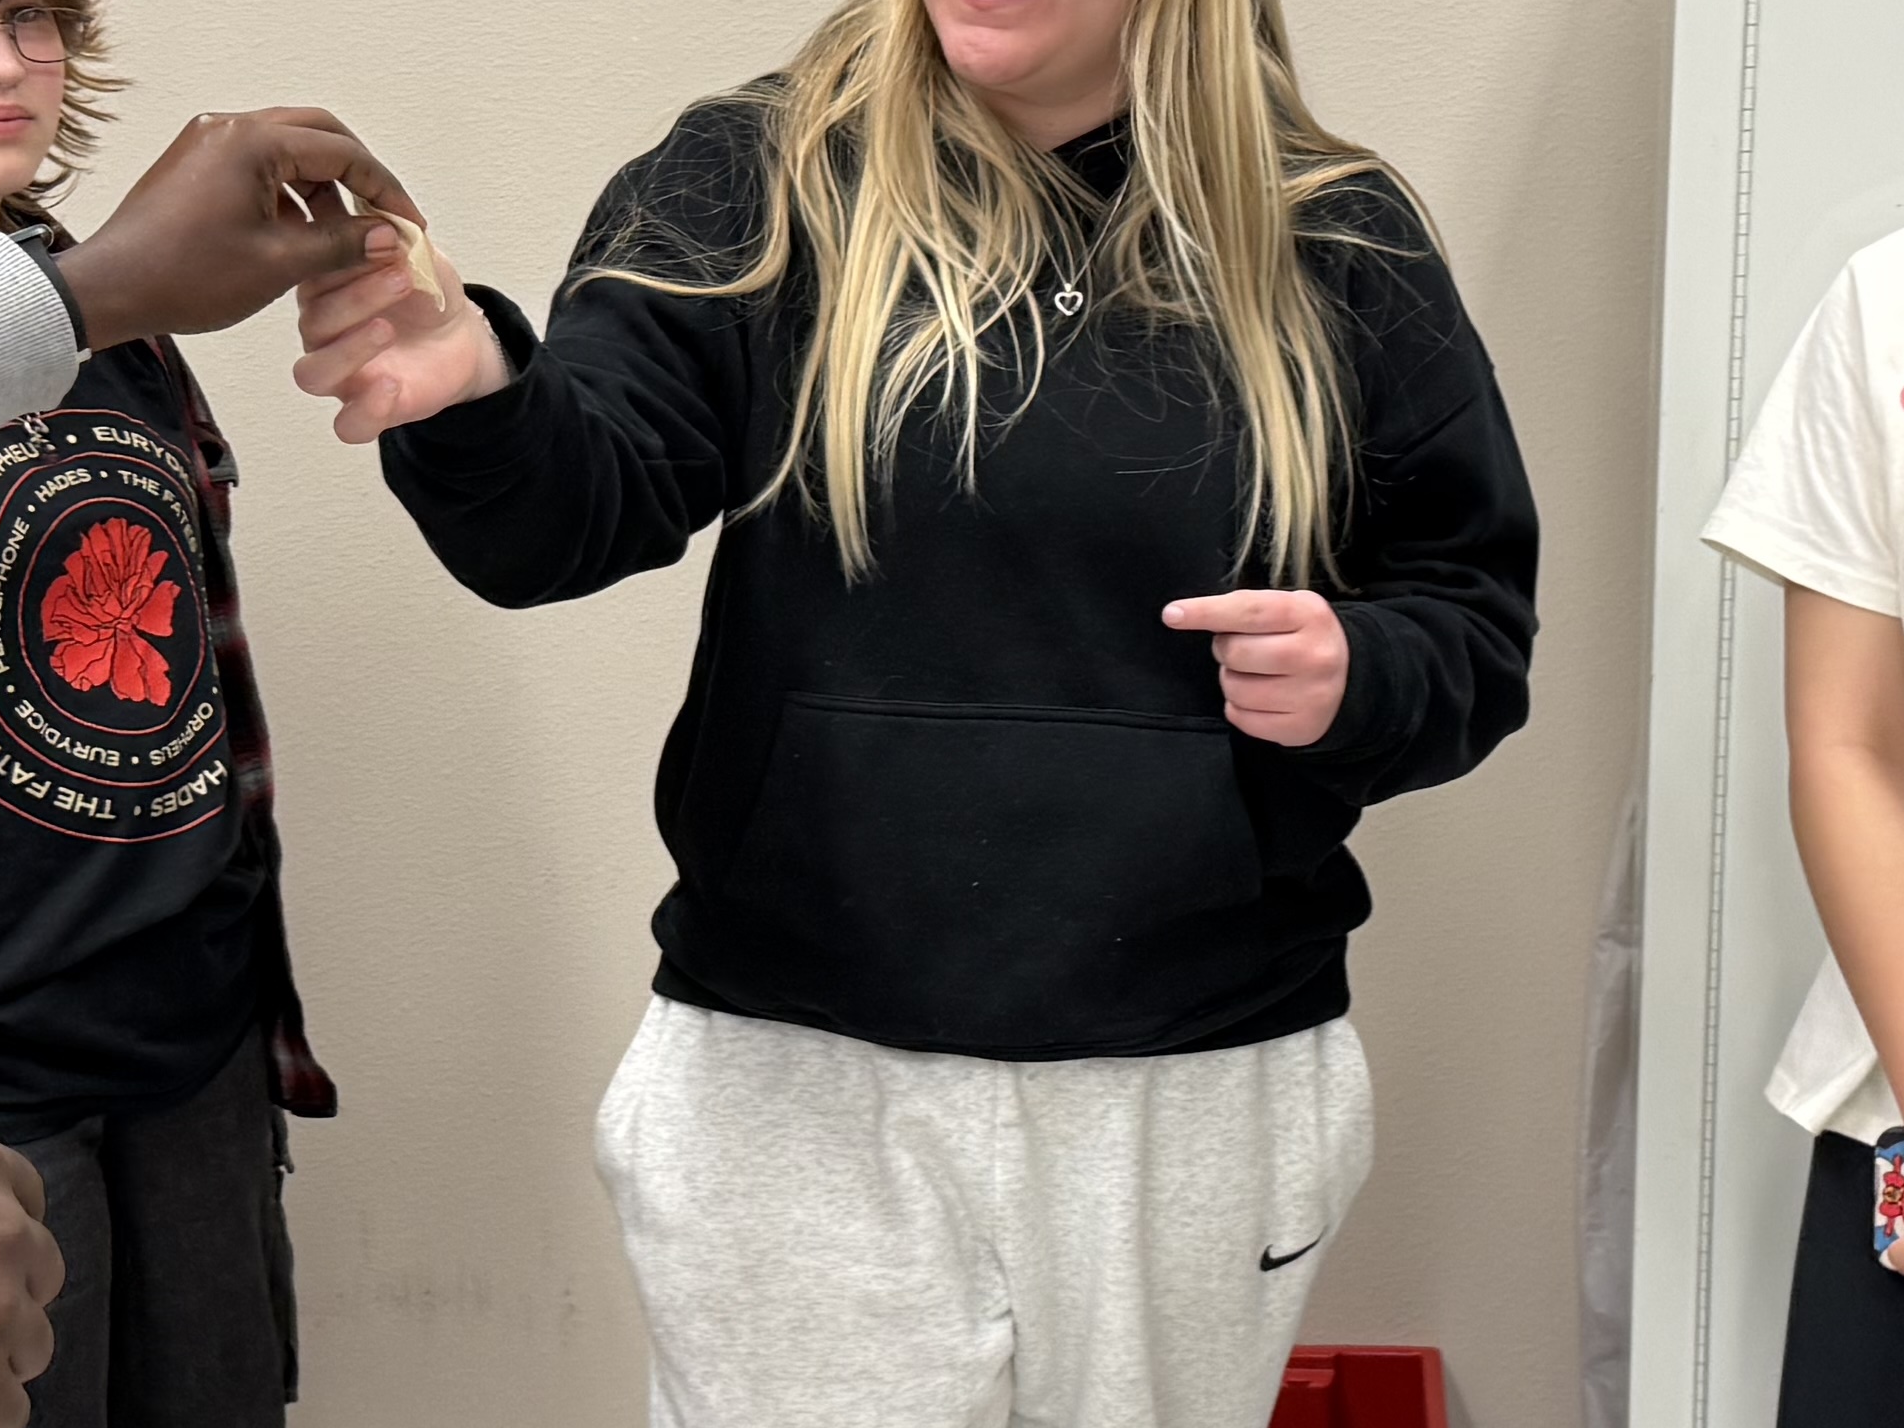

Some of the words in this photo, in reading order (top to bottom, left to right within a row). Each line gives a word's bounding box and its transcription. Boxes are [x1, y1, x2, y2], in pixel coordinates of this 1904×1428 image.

[34, 468, 92, 502] HADES
[117, 469, 162, 496] THE
[14, 699, 120, 767] EURYDICE
[148, 702, 214, 766] ORPHEUS
[53, 786, 117, 820] THE
[150, 759, 228, 817] HADES
